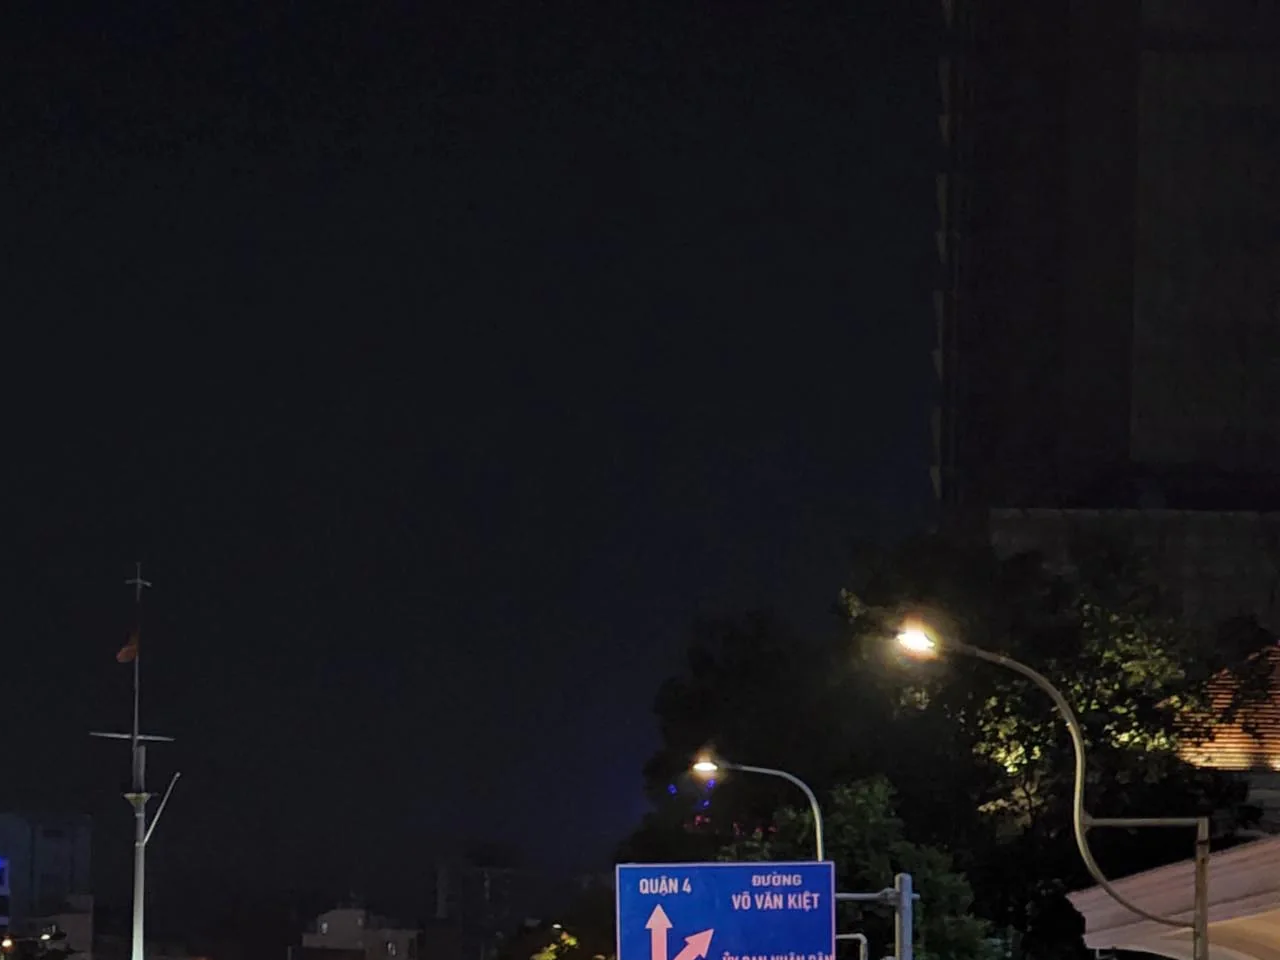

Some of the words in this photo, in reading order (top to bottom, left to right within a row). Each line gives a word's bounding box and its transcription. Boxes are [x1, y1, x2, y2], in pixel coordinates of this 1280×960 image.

[639, 876, 678, 896] QUẬN
[682, 878, 692, 894] 4
[751, 873, 802, 887] ĐƯỜNG
[732, 892, 751, 911] VÕ
[755, 891, 783, 910] VĂN
[788, 892, 820, 912] KIỆT
